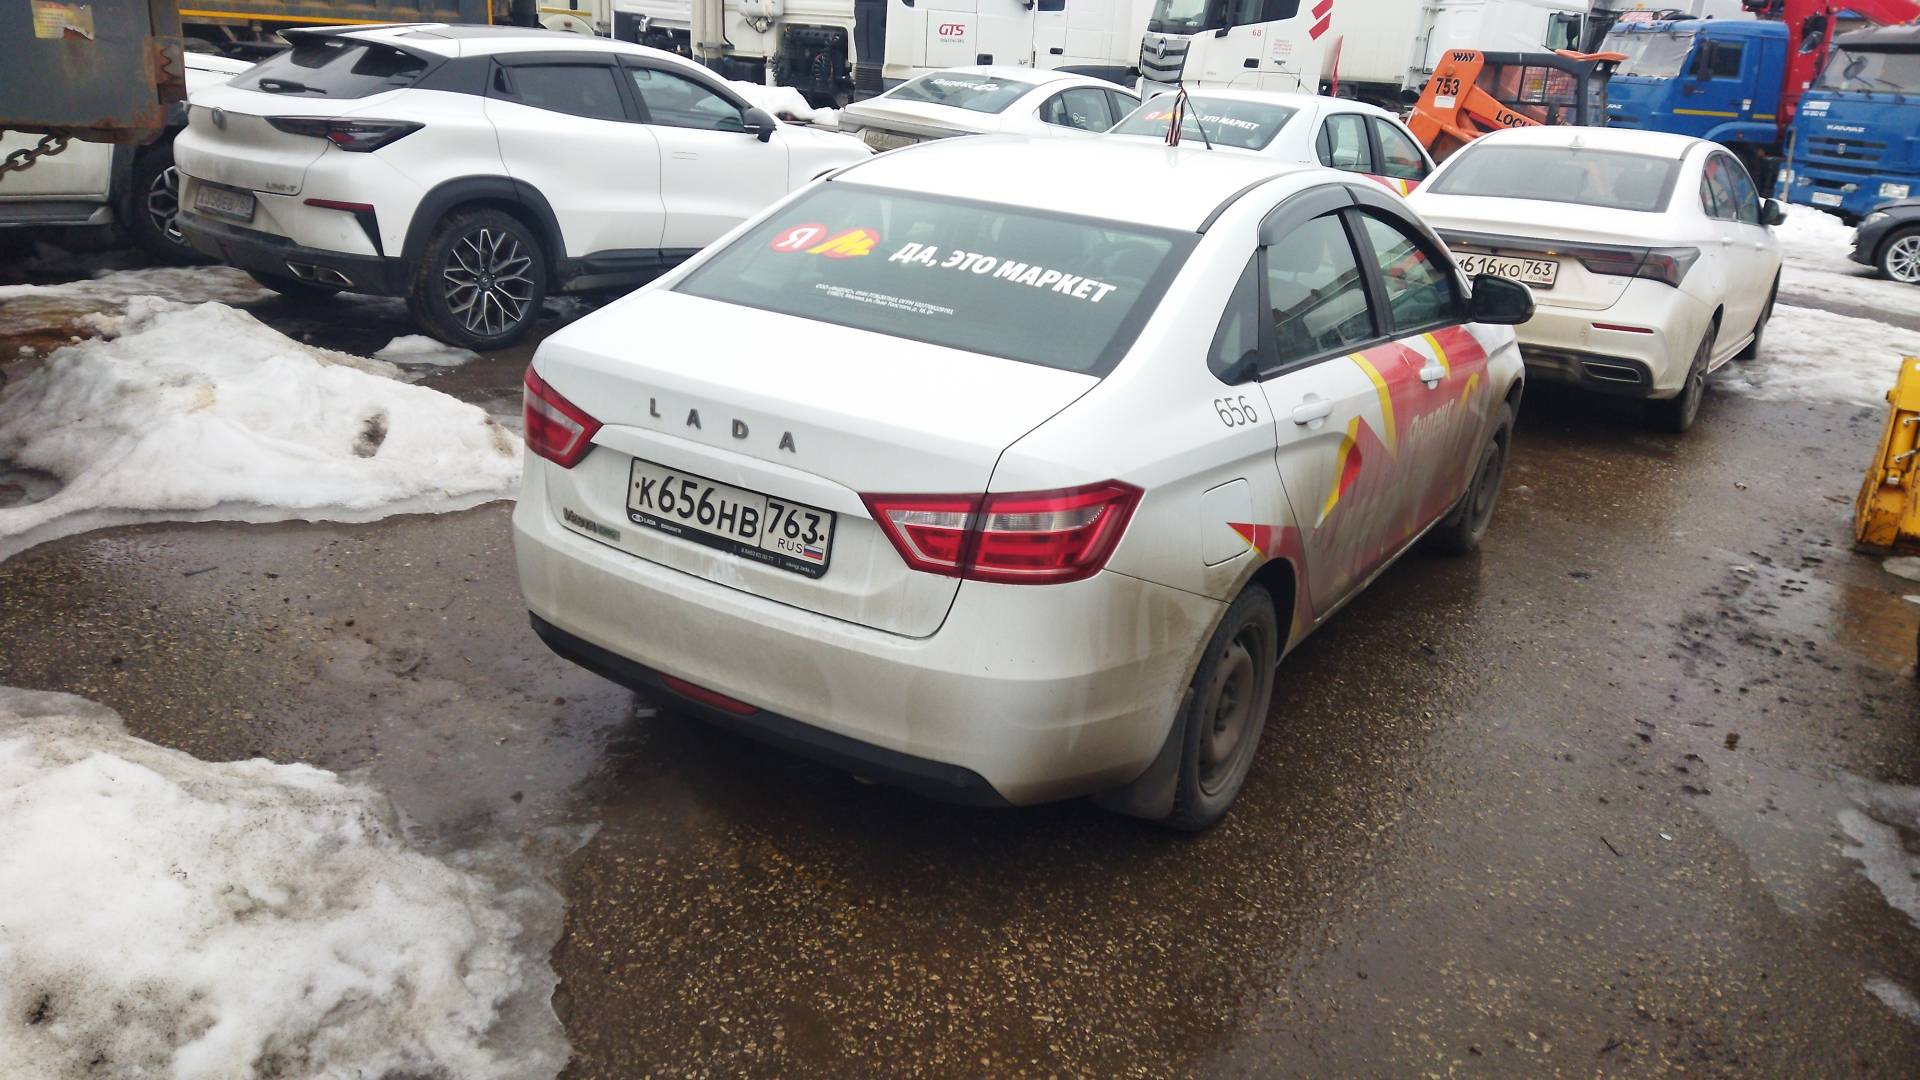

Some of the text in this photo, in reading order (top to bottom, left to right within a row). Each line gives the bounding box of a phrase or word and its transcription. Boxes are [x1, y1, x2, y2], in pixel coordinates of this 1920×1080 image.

[939, 23, 965, 36] GTS
[1252, 29, 1262, 37] 68
[1453, 52, 1476, 62] WAY
[1435, 77, 1460, 97] 753
[1219, 117, 1261, 131] МАРКЕТ
[1495, 110, 1532, 129] LOC
[888, 242, 1118, 304] ДА, ЭТО МАРКЕТ
[1525, 260, 1553, 276] 763
[1214, 395, 1258, 428] 656
[650, 398, 796, 453] LADA
[639, 475, 822, 545] К656НВ 763
[777, 537, 804, 555] RUS
